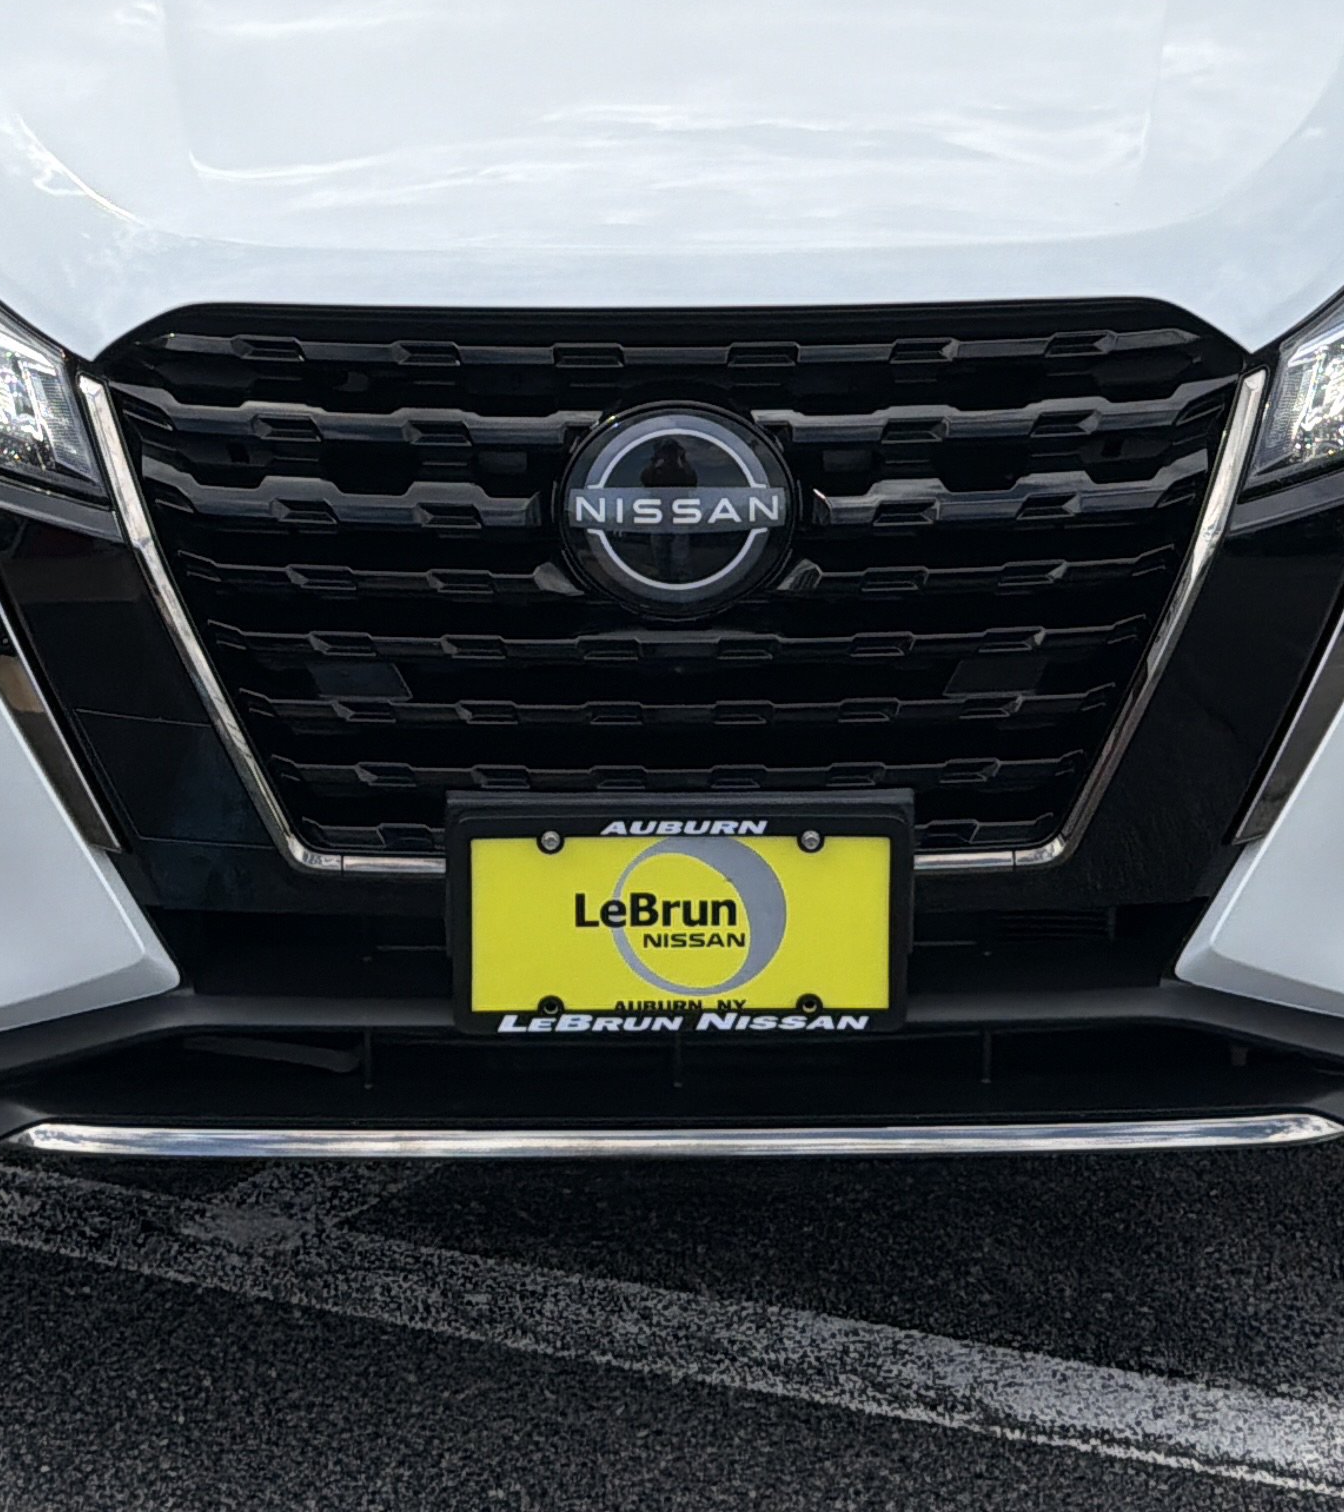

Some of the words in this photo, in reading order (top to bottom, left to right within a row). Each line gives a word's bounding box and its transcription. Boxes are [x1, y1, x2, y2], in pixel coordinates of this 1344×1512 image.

[575, 495, 779, 524] NISSAN
[600, 820, 768, 835] AUBURN
[575, 892, 737, 928] LeBrun
[643, 933, 745, 948] NISSAN
